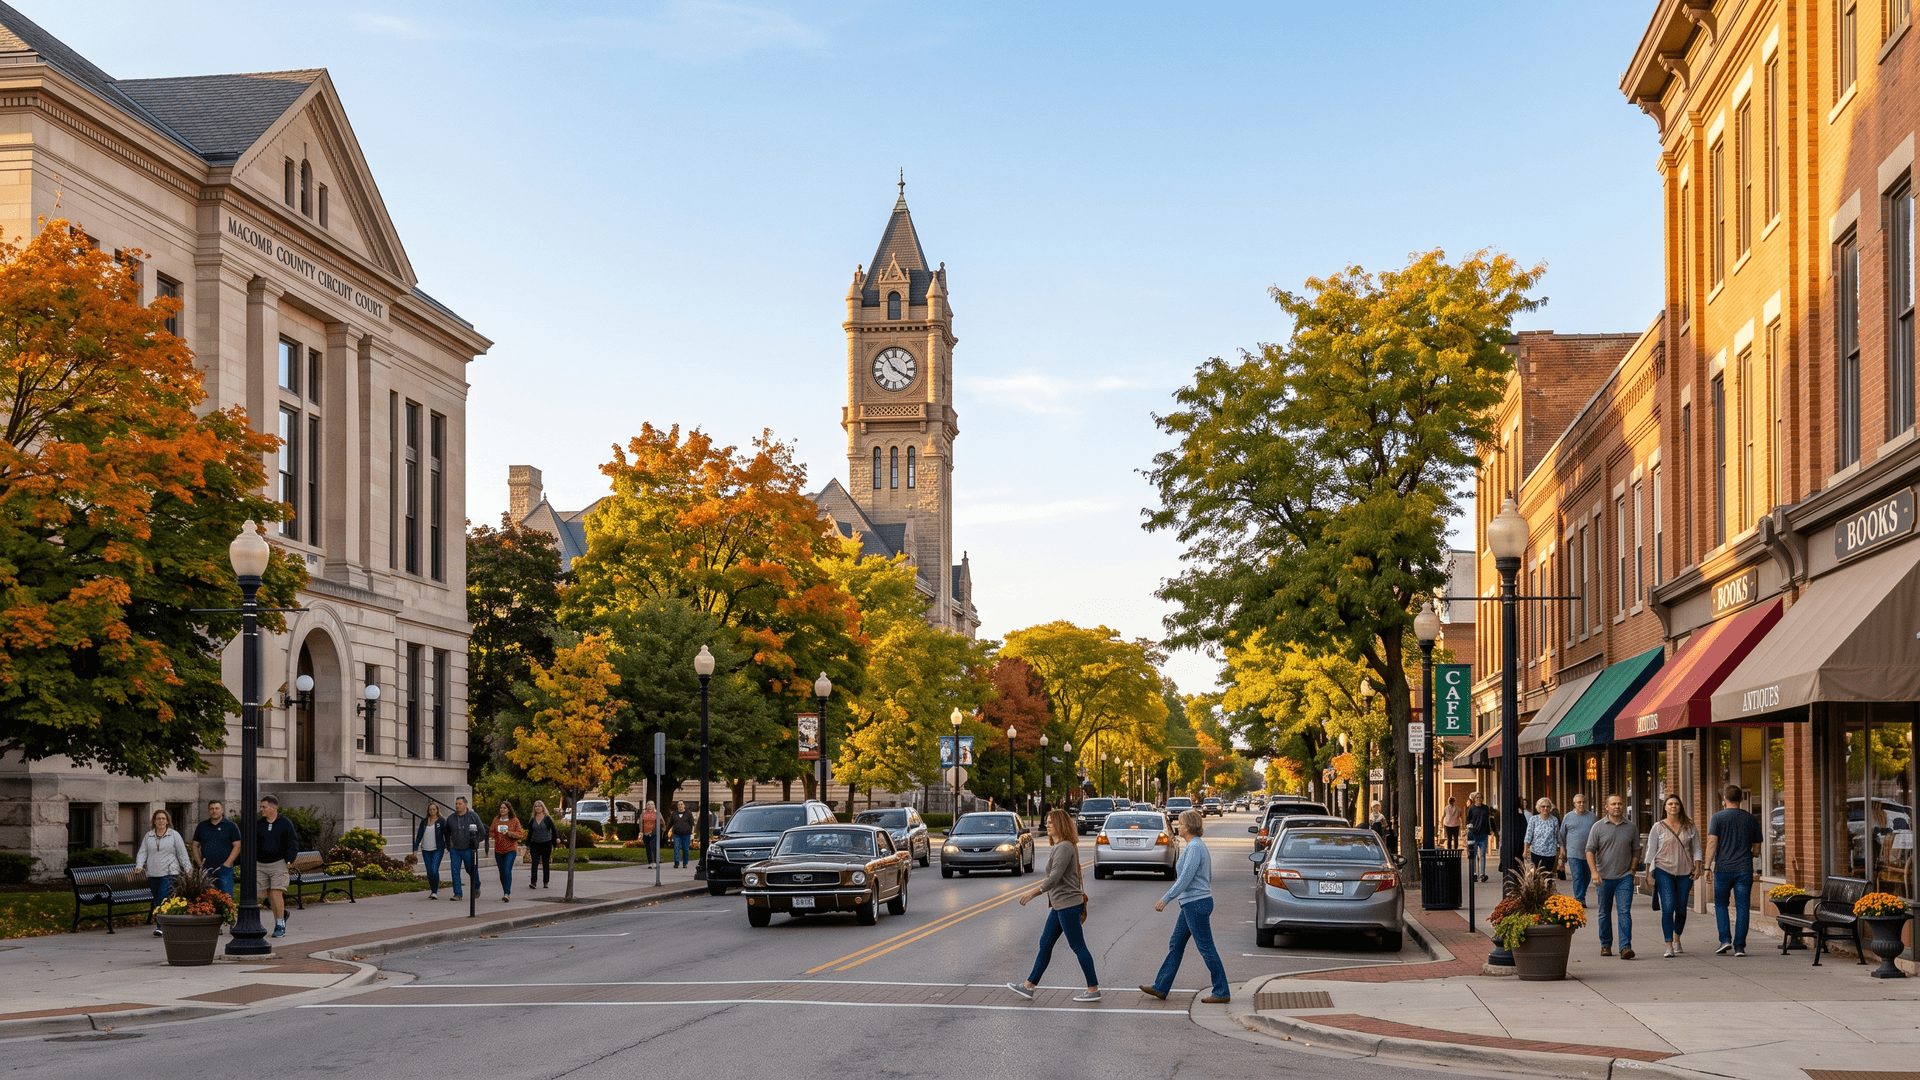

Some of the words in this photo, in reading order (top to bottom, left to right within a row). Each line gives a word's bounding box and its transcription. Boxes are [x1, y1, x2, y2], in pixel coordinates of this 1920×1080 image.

[228, 216, 273, 256] MACOMB
[276, 246, 316, 281] COUNTY
[317, 270, 353, 302] CIRCUIT
[355, 291, 383, 319] COURT
[1846, 499, 1898, 551] BOOKS
[1717, 575, 1748, 611] BOOKS
[1445, 670, 1461, 730] CAFE
[1742, 685, 1780, 712] ANTIQUES
